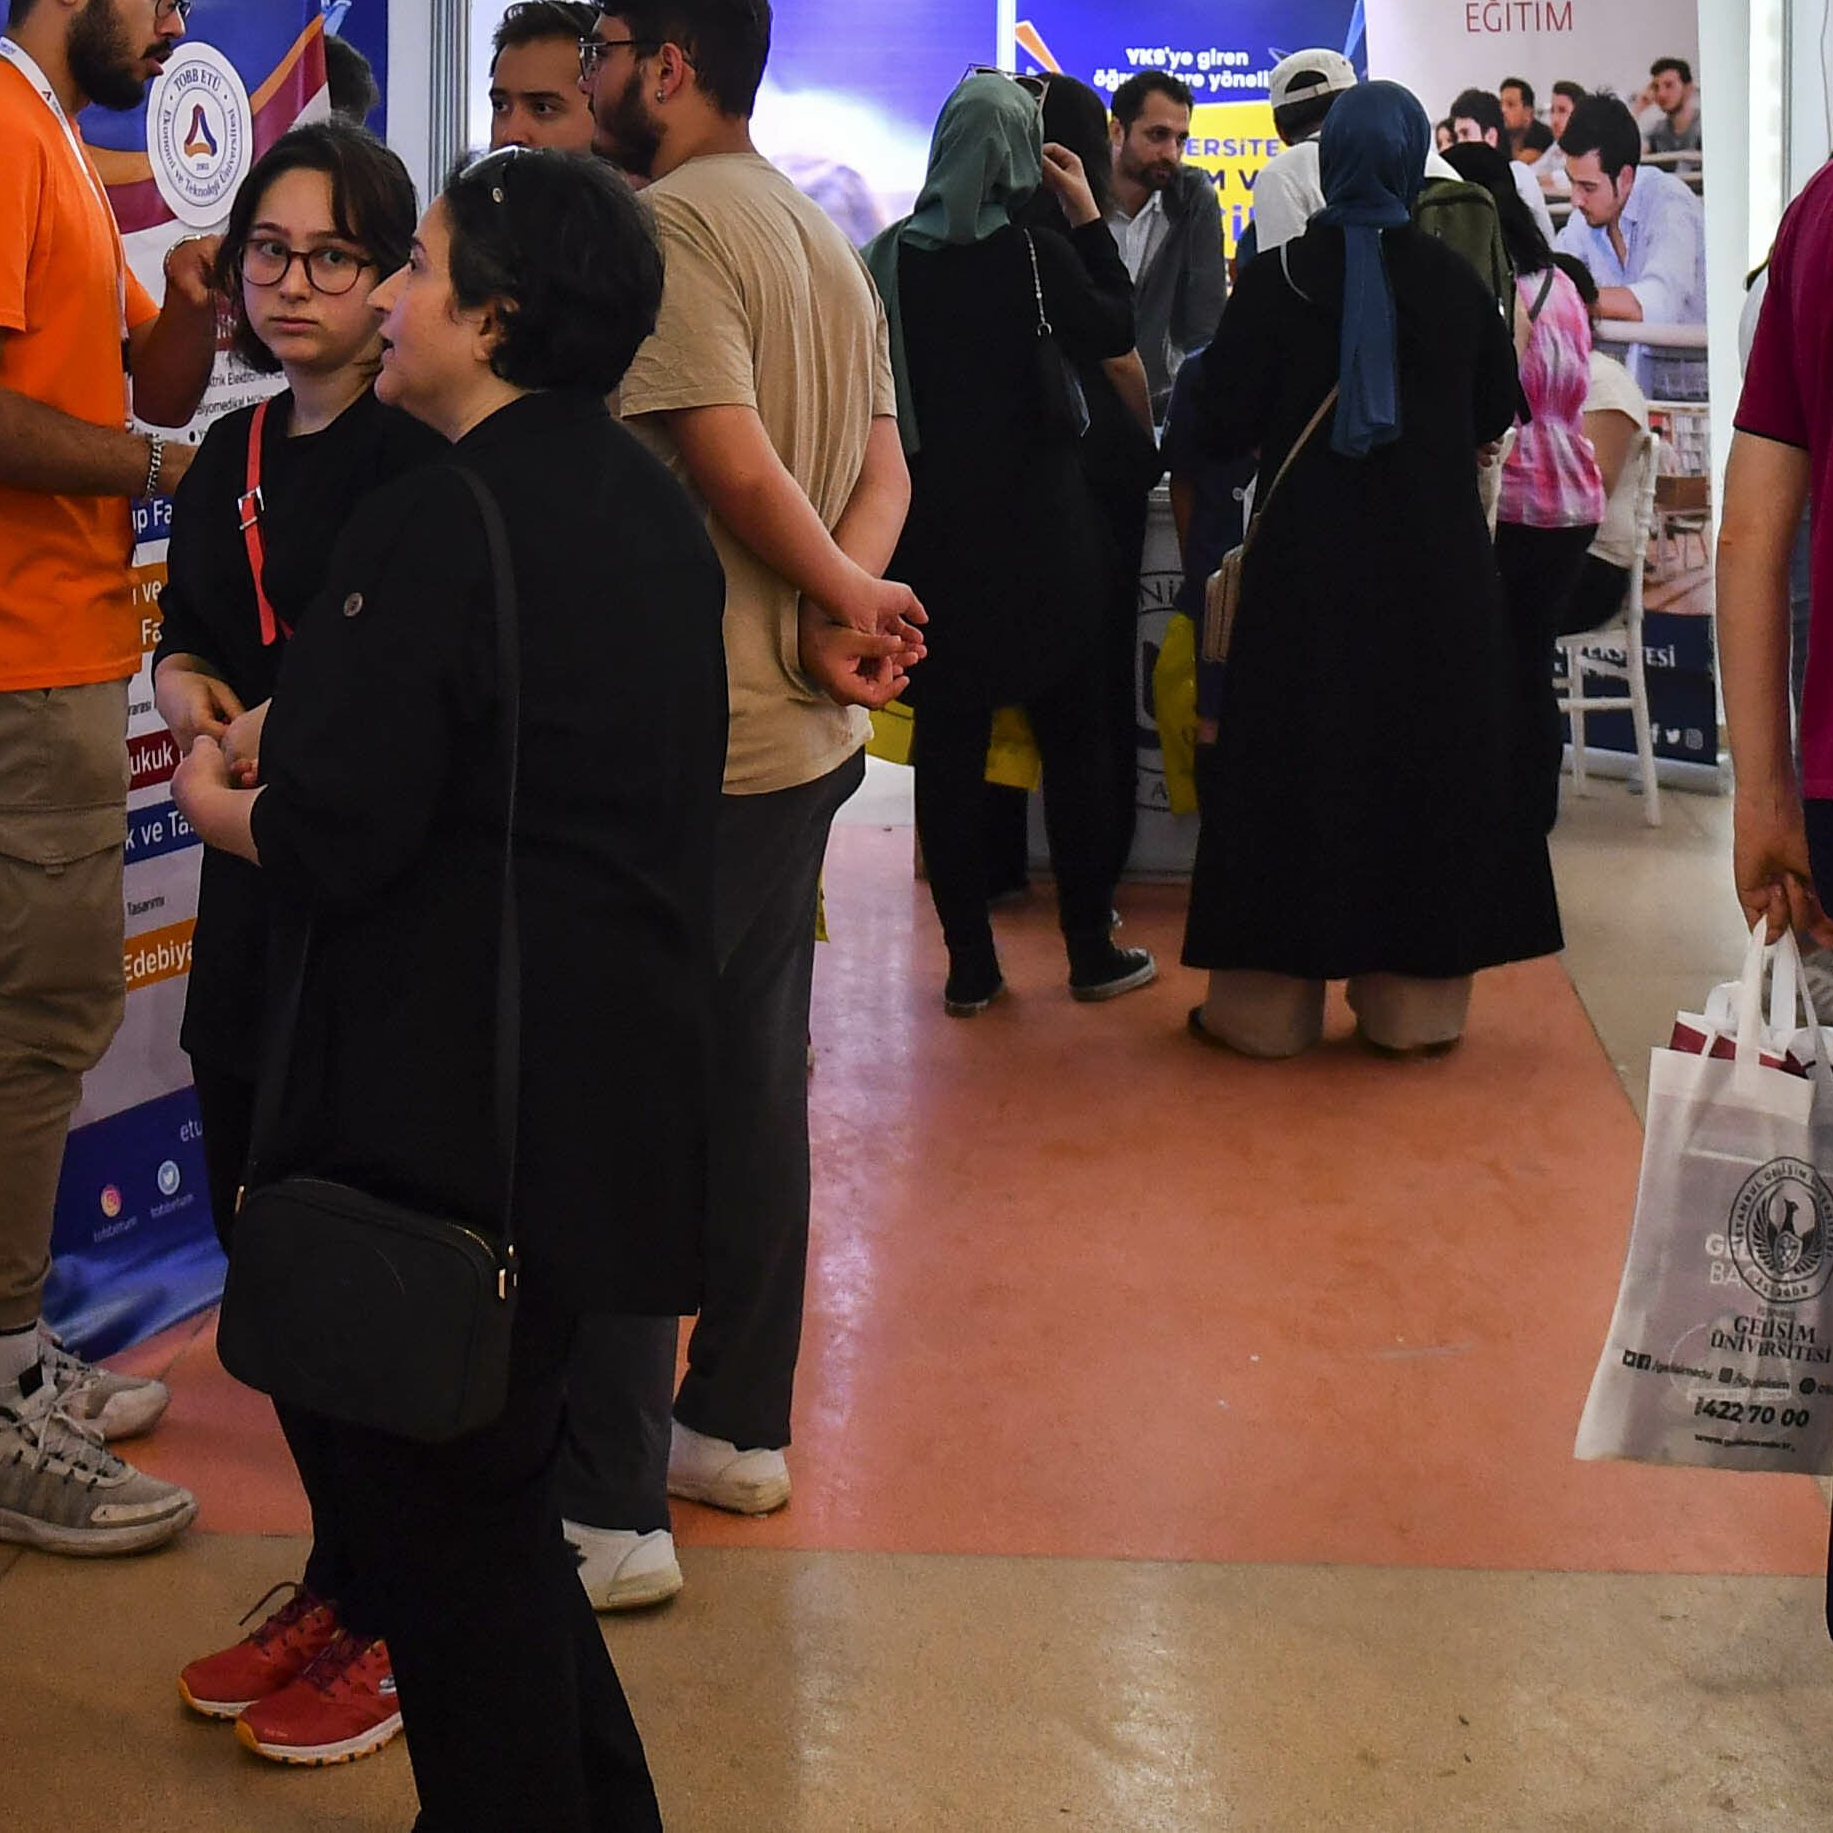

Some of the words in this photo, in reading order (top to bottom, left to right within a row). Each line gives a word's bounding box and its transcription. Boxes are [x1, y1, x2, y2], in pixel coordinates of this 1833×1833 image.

[173, 68, 199, 92] TOBB
[201, 69, 221, 92] ETÜ
[130, 741, 173, 775] ukuk
[141, 822, 163, 844] ve
[123, 941, 193, 982] Edebiya
[1703, 1399, 1745, 1423] 422
[1748, 1405, 1776, 1425] 70
[1780, 1409, 1811, 1428] 00
